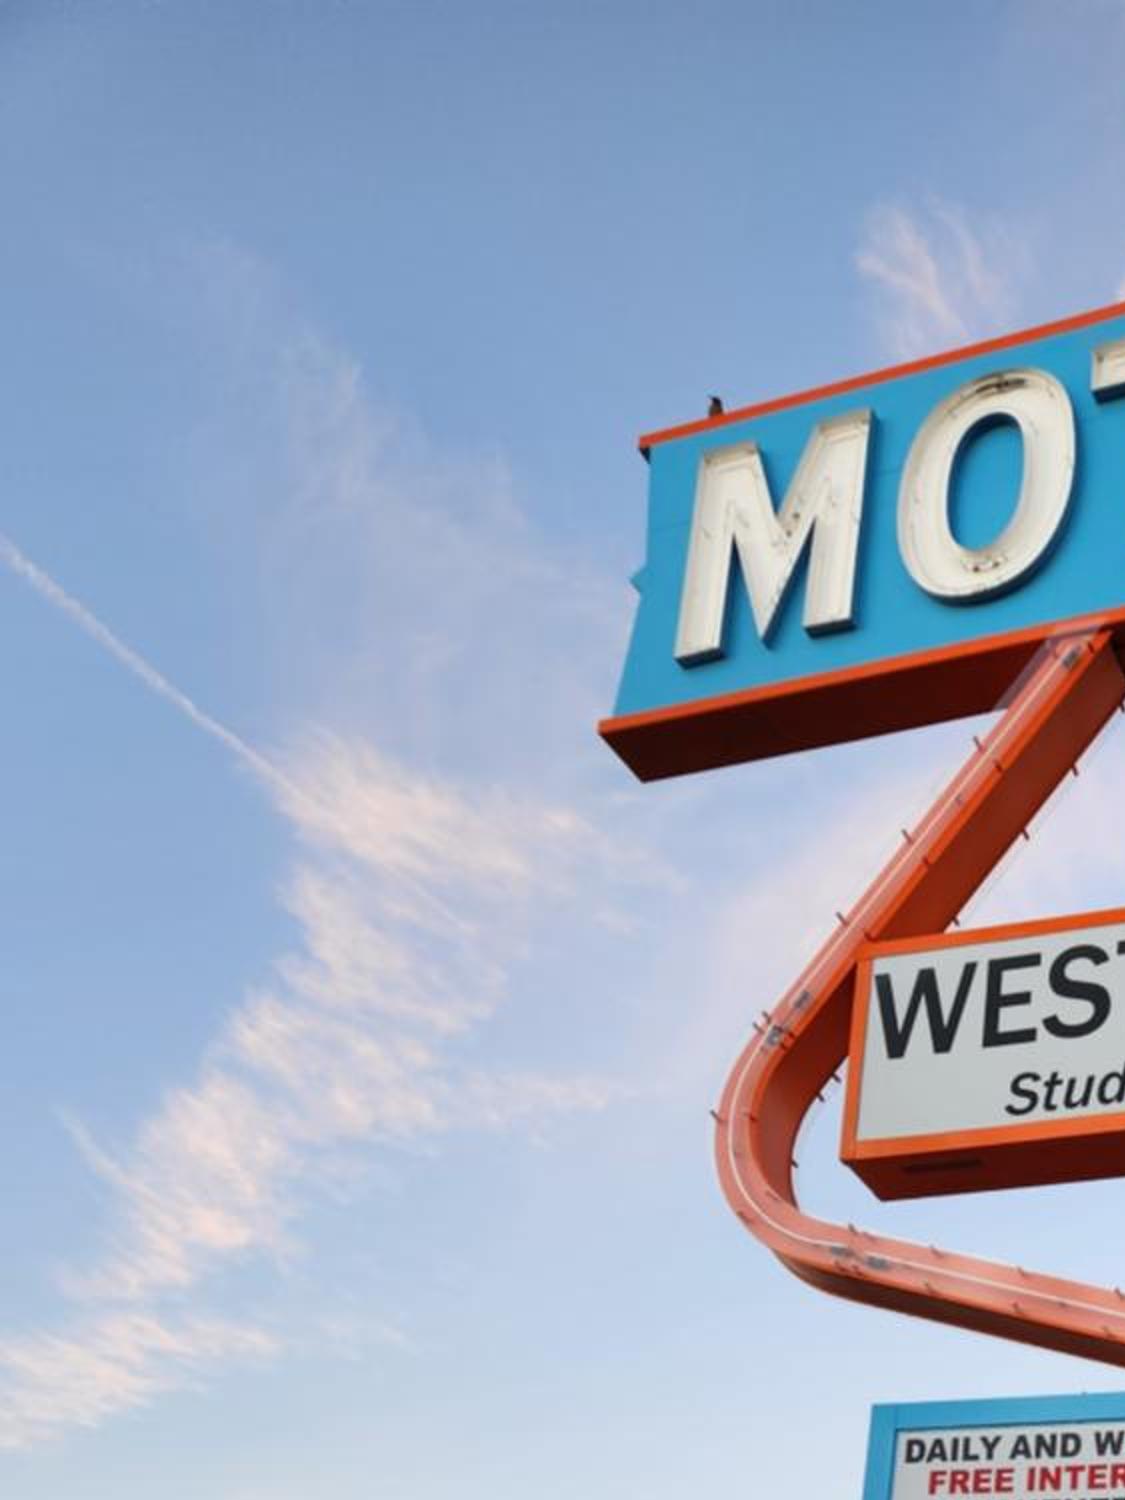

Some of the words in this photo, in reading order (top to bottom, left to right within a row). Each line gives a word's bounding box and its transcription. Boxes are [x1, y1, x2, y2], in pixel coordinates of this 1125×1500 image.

[904, 1435, 1001, 1464] DAILY
[1009, 1432, 1082, 1460] AND
[928, 1469, 1015, 1494] FREE
